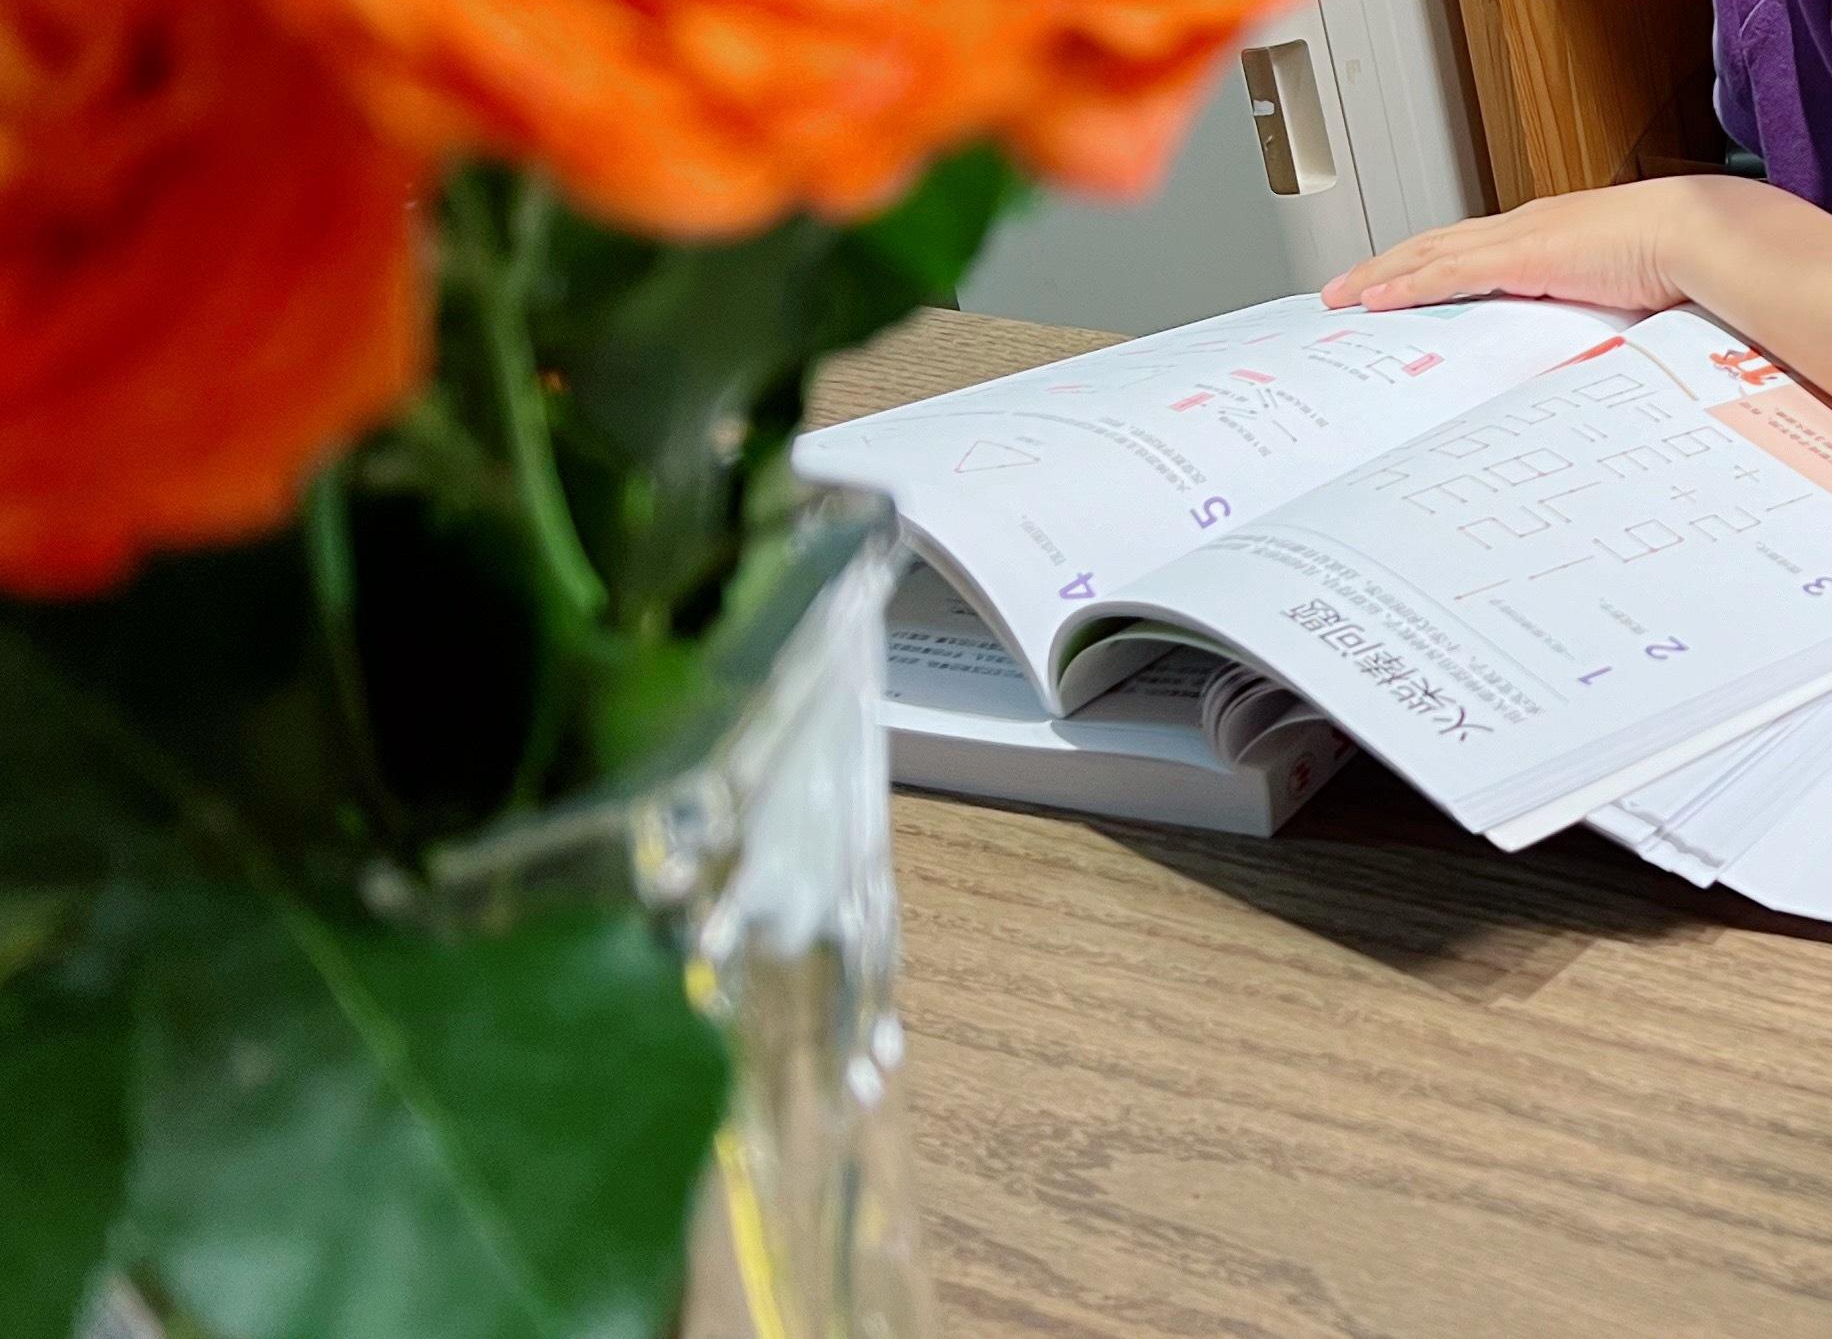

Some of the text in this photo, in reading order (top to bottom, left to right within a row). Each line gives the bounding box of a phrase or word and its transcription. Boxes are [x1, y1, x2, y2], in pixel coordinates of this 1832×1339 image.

[1190, 494, 1233, 531] 5
[1059, 570, 1097, 603] 4
[1644, 635, 1690, 660] 2
[1281, 597, 1494, 742] 火柴棒问题
[1578, 665, 1612, 686] 1
